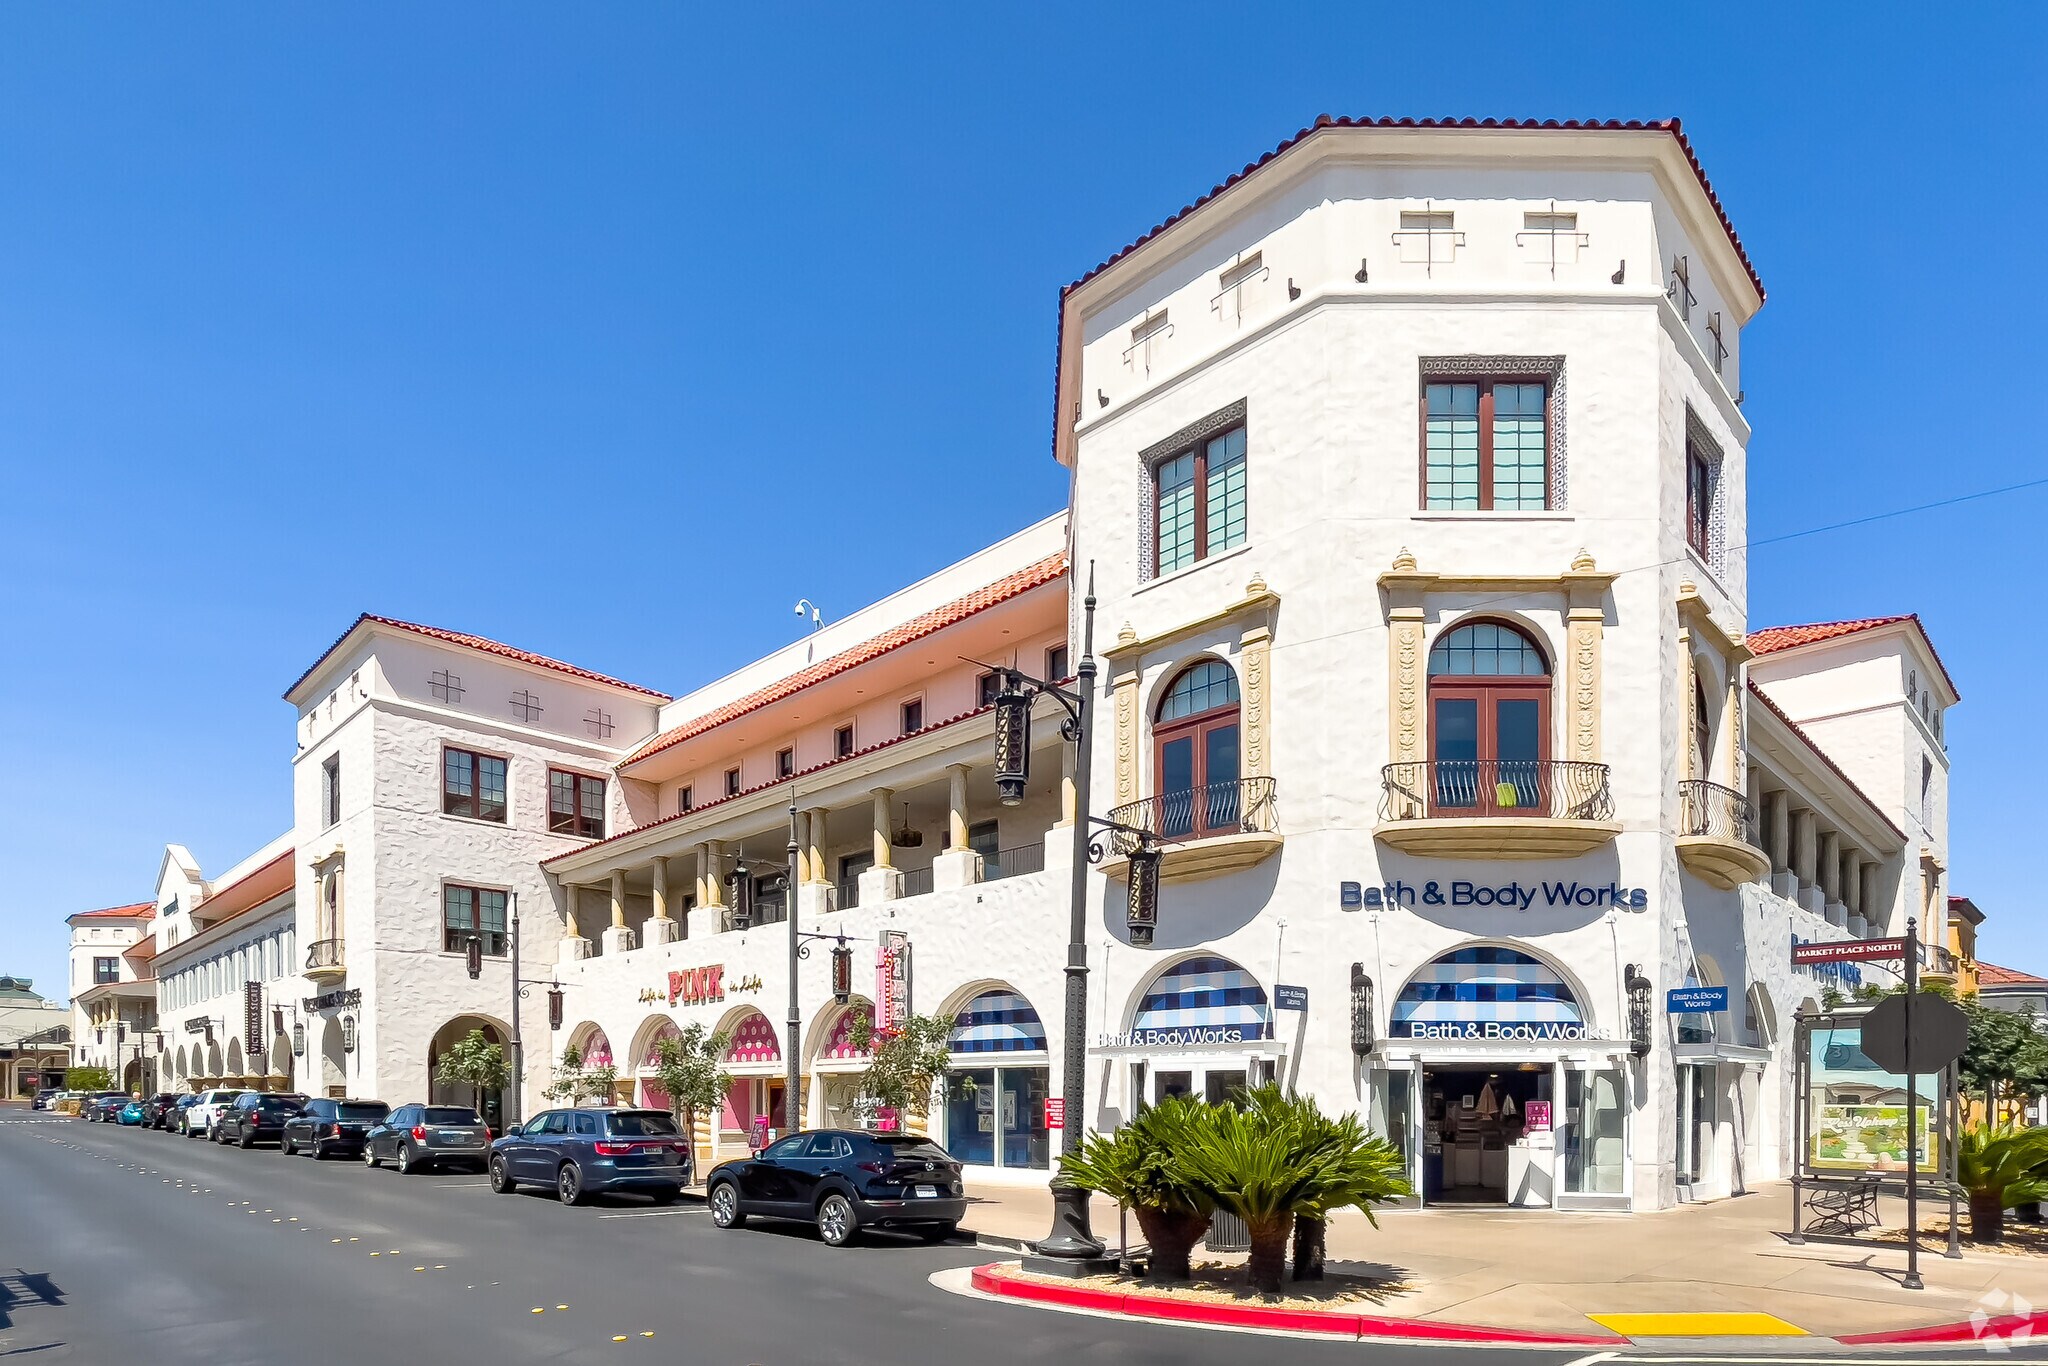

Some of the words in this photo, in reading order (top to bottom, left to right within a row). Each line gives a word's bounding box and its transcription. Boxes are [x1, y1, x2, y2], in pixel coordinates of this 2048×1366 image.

[1340, 881, 1415, 911] Bath
[1422, 881, 1446, 905] &
[1451, 881, 1537, 911] Body
[1541, 881, 1647, 913] Works
[1796, 949, 1834, 957] MARKET
[1835, 946, 1865, 954] PLACE
[1866, 944, 1902, 952] NORTH
[668, 964, 725, 1008] PINK
[1673, 993, 1692, 1001] Bath
[251, 985, 259, 1011] SECRET
[251, 1012, 259, 1052] VICTORIA'S
[1133, 1031, 1143, 1046] &
[1146, 1030, 1187, 1047] Body
[1188, 1027, 1242, 1043] Works
[1410, 1022, 1461, 1040] Bath
[1464, 1023, 1482, 1040] &
[1485, 1022, 1541, 1043] Body
[1543, 1022, 1611, 1041] Works
